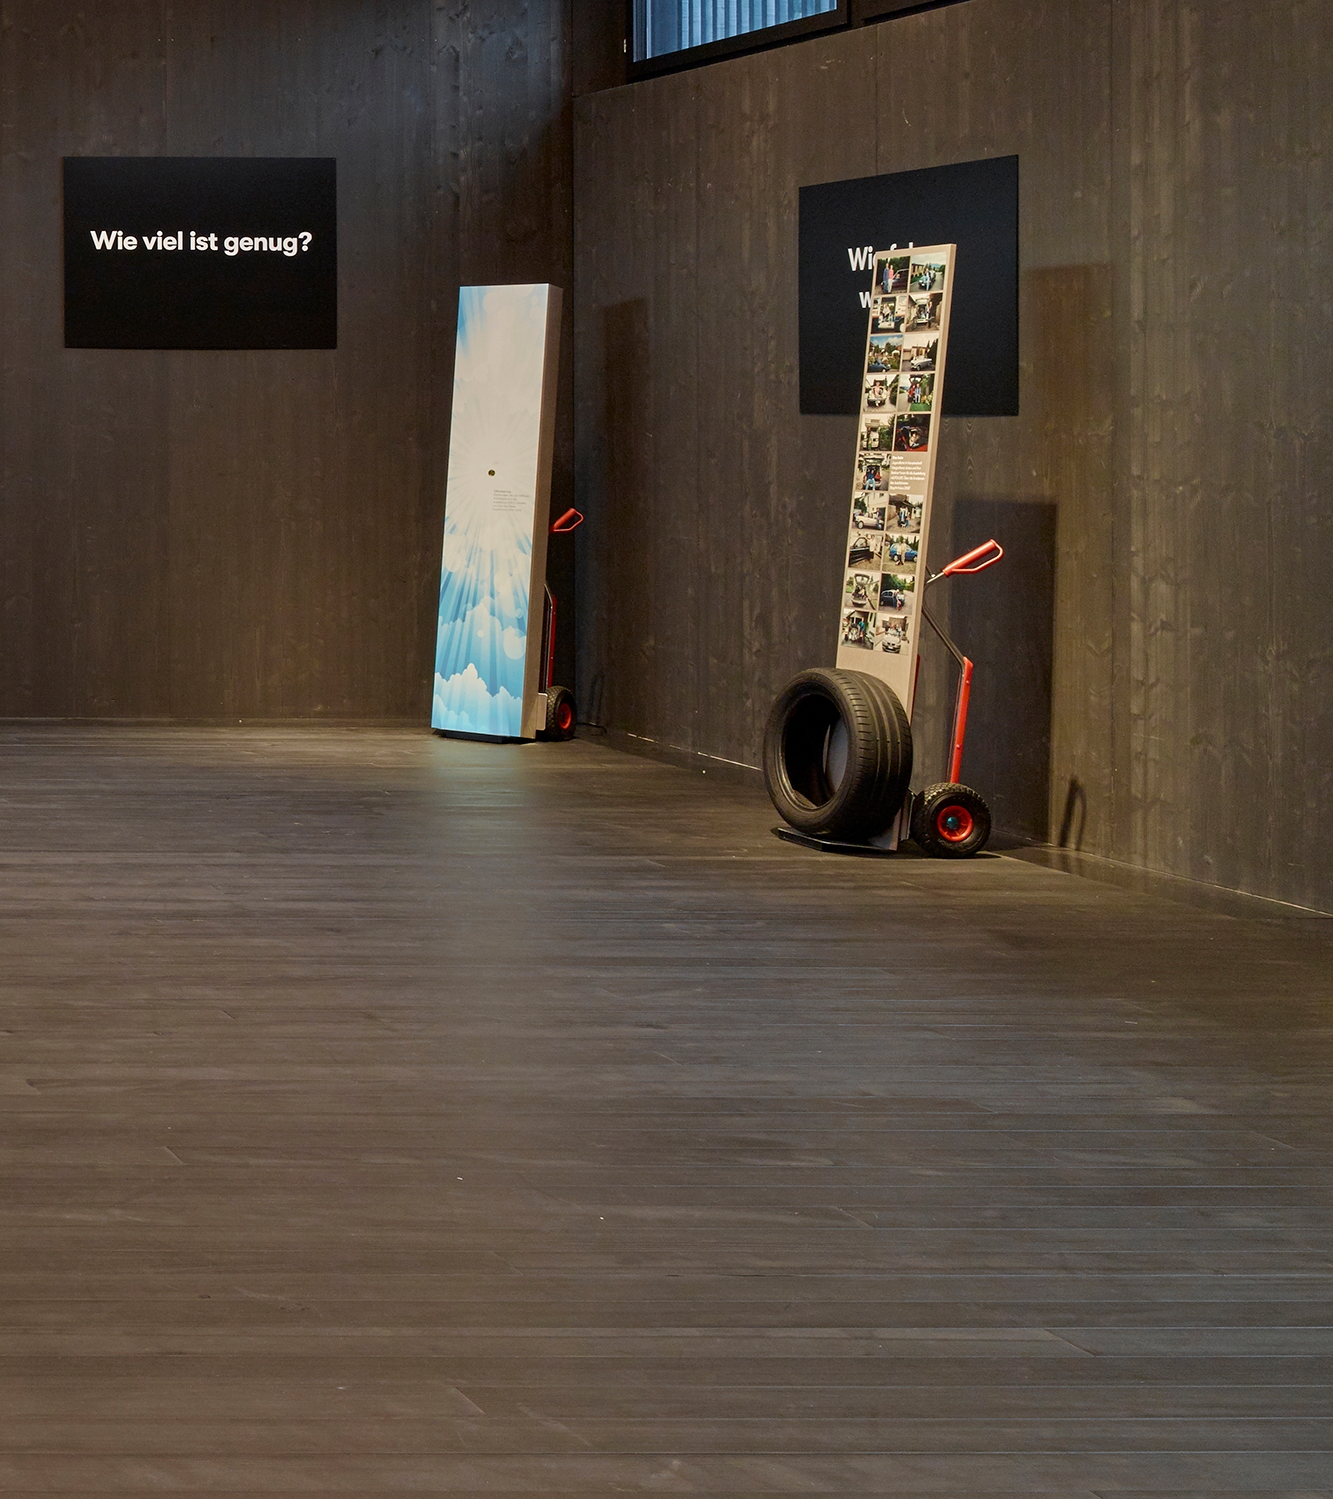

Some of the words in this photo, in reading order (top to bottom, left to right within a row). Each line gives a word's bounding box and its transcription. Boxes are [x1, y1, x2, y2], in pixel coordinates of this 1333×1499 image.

[90, 230, 138, 251] Wie
[142, 230, 184, 251] viel
[189, 230, 219, 251] ist
[224, 231, 313, 257] genug?
[847, 245, 876, 272] Wi
